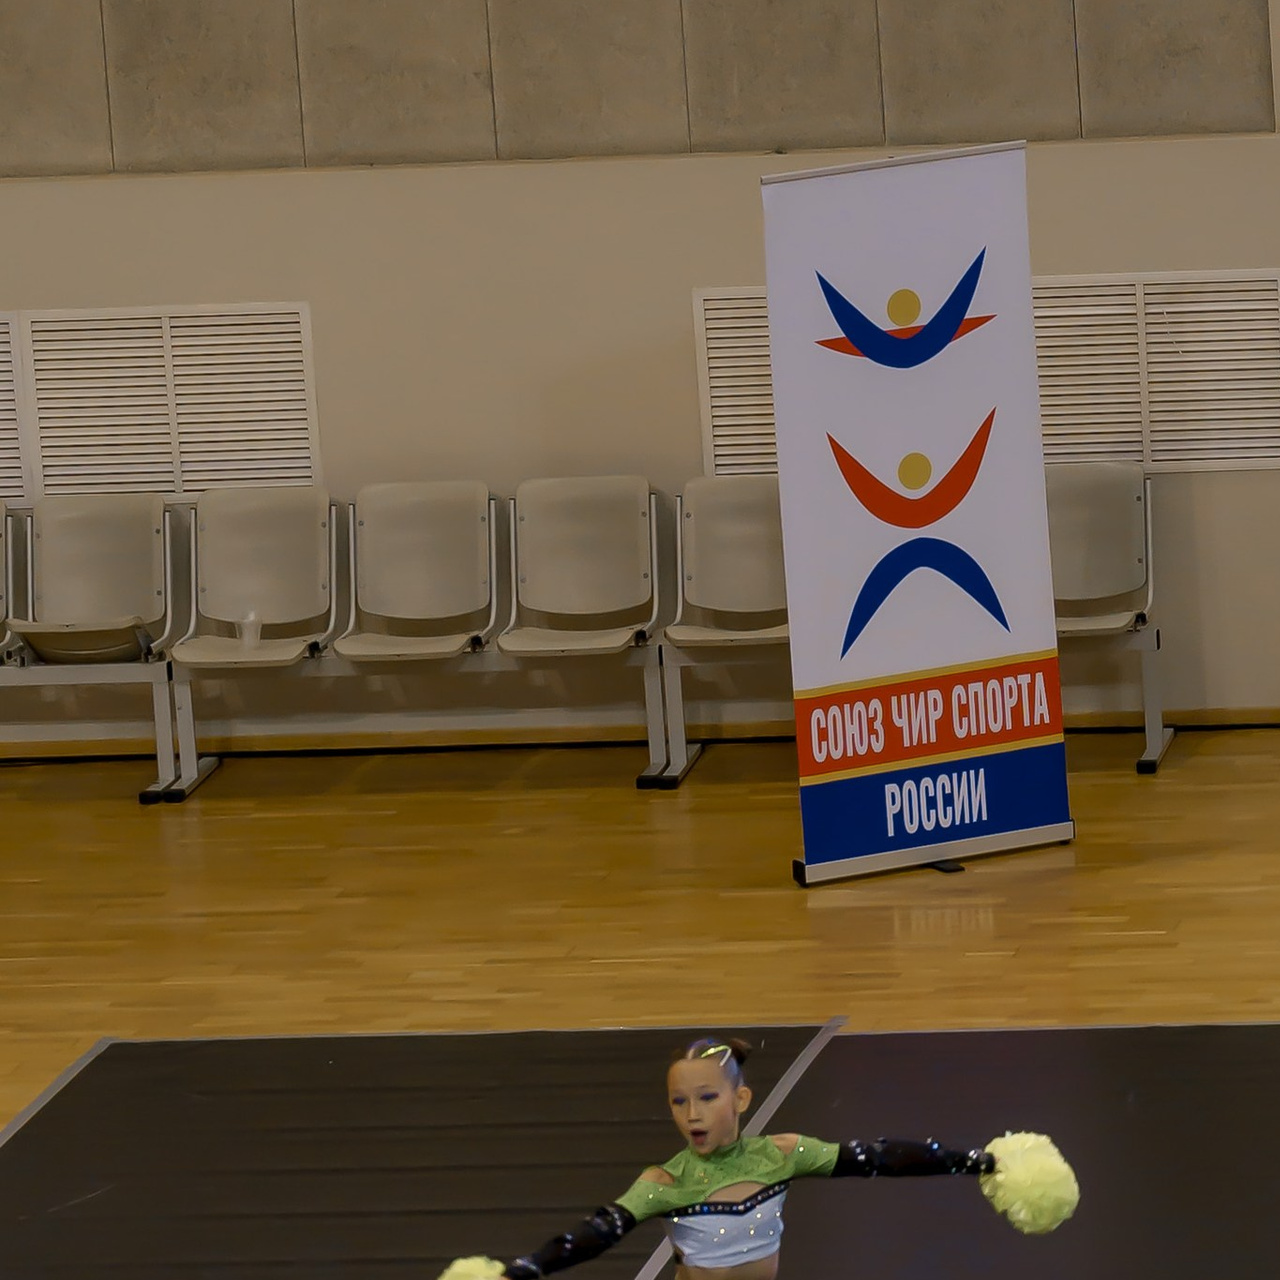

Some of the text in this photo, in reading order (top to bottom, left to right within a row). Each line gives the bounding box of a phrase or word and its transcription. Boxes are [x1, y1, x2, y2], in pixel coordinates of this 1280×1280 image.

[810, 671, 1050, 763] СОЮЗ ЧИР СПОРТА
[884, 768, 988, 837] РОССИИ
